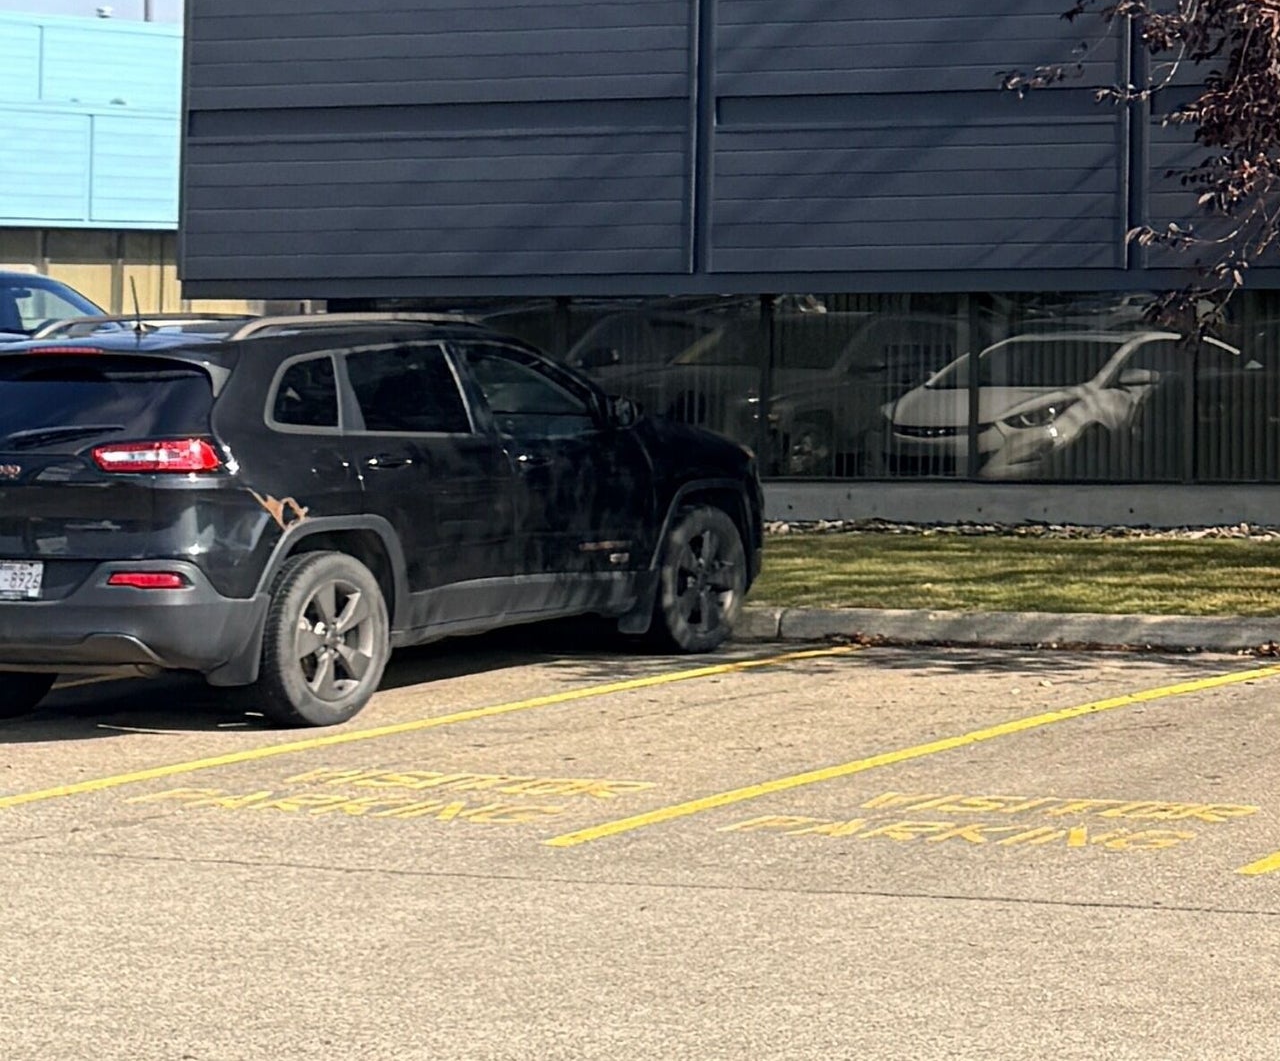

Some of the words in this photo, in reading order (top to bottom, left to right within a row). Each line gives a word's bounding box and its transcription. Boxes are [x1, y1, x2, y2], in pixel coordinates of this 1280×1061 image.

[284, 767, 659, 799] VISITOR
[122, 787, 565, 824] PARKING
[859, 791, 1261, 823] VISITOR
[717, 814, 1198, 850] PARKING
